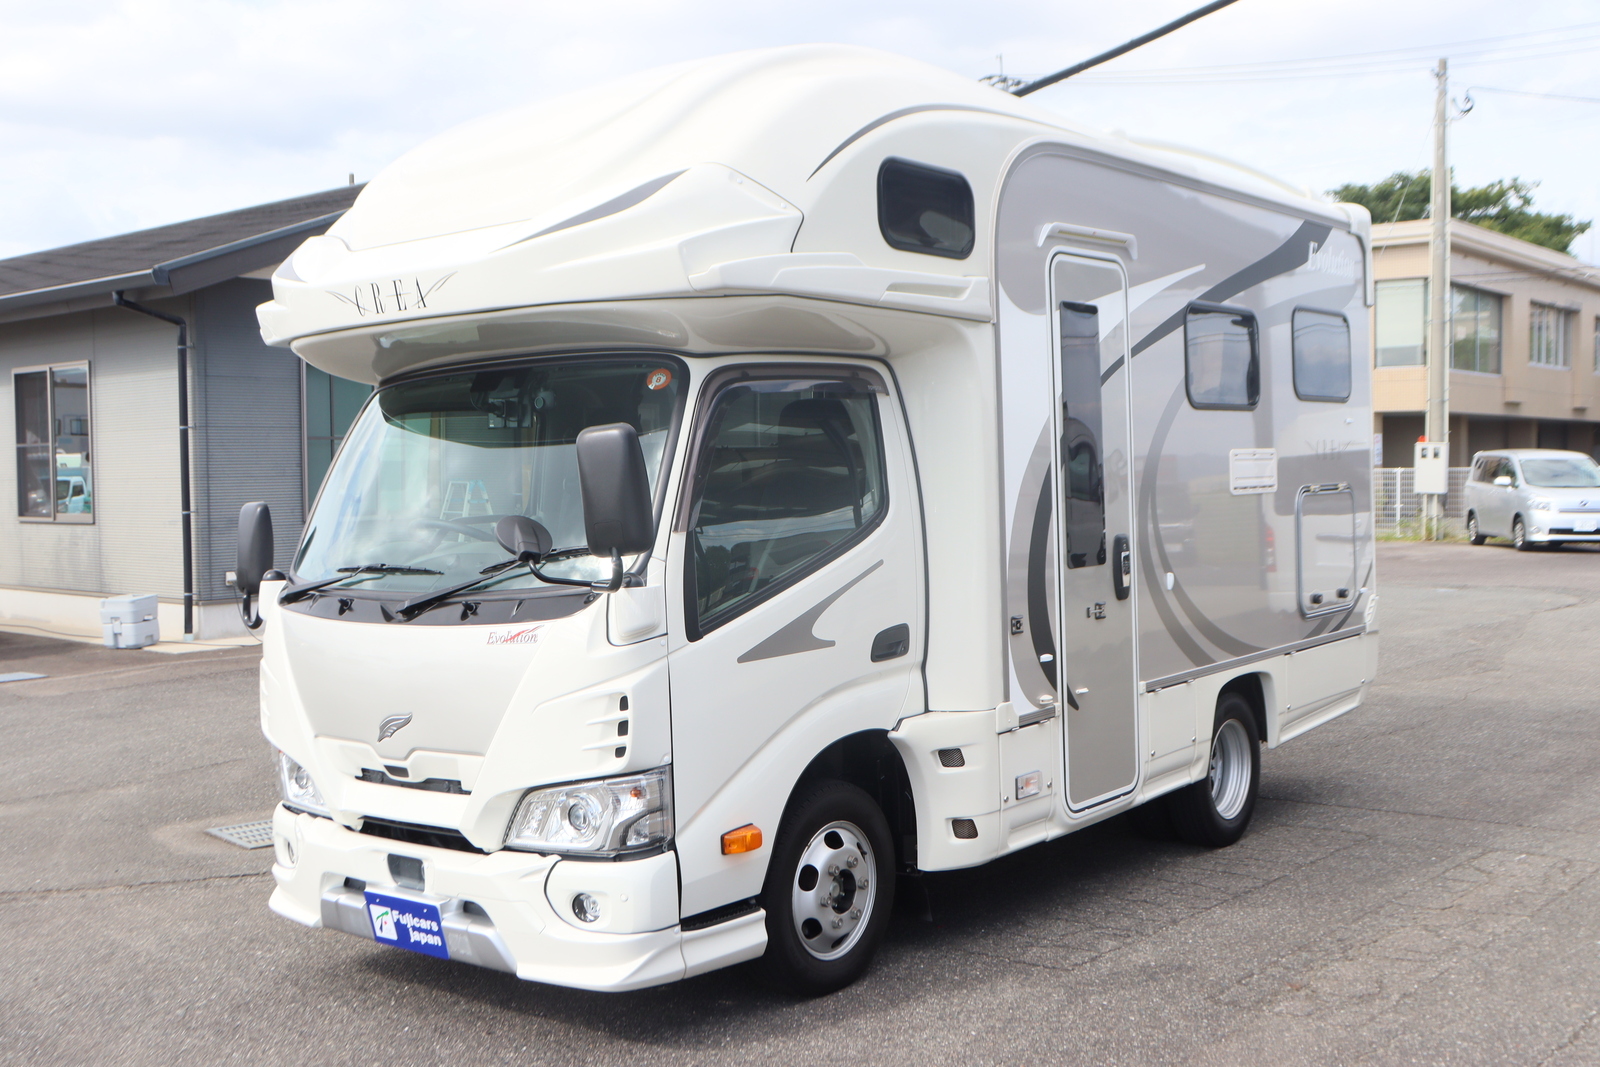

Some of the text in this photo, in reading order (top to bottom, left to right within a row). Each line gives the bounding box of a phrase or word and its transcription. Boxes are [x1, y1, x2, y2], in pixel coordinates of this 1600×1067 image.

[354, 276, 427, 317] CREA
[486, 631, 539, 645] Evolution
[392, 909, 439, 932] Fujicars
